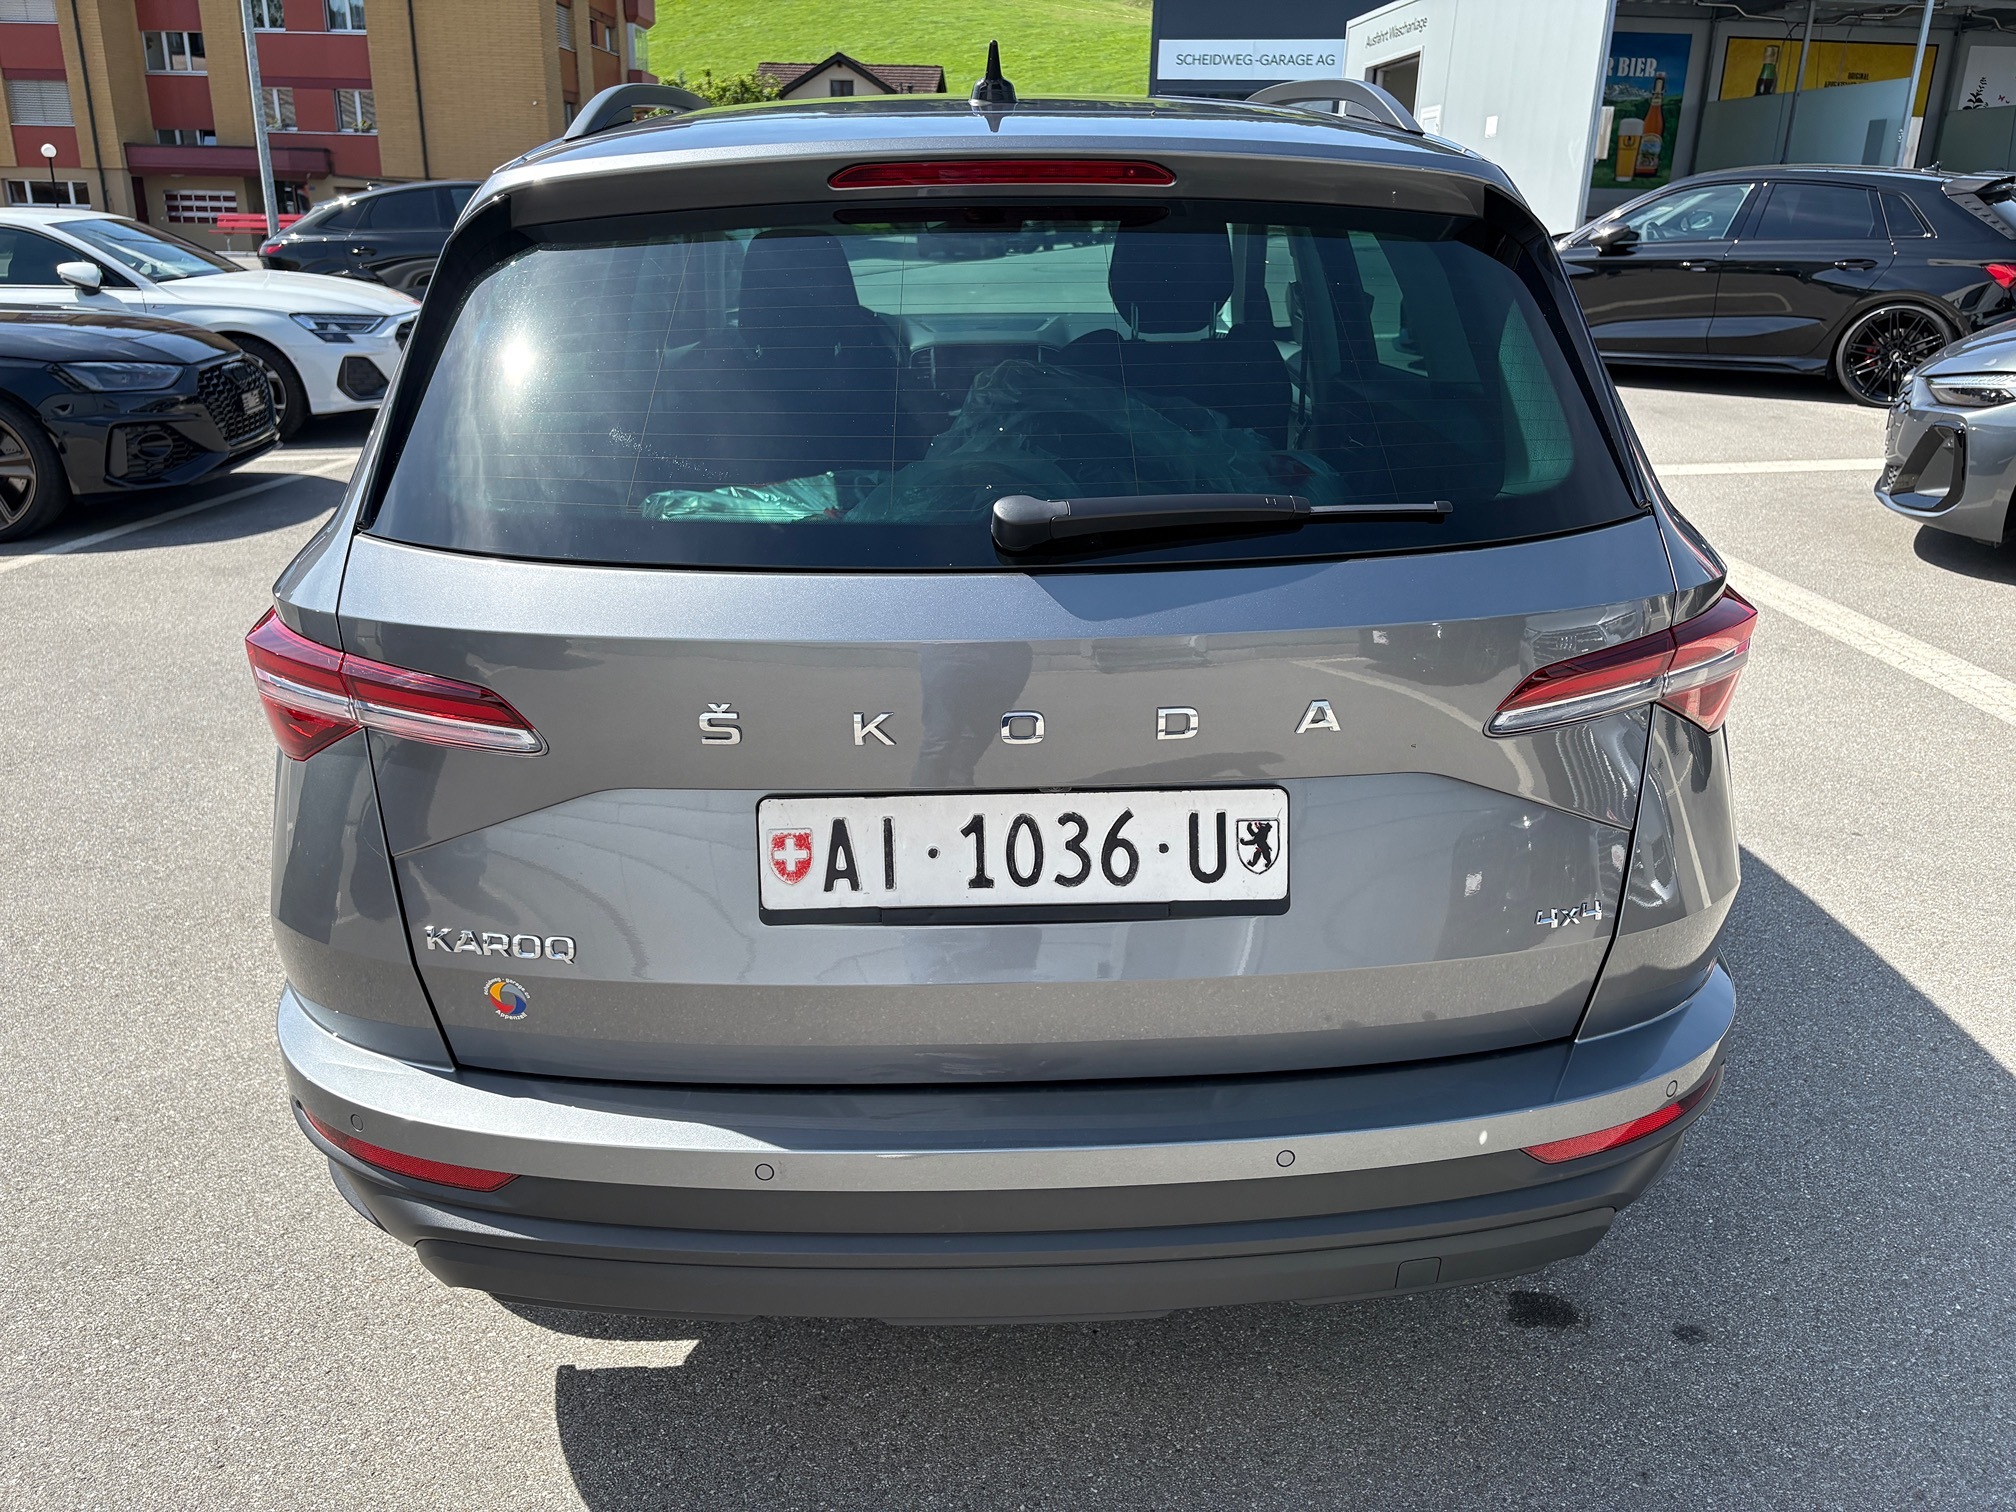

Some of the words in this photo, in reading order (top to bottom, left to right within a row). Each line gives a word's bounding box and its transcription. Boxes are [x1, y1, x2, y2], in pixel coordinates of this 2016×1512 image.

[1365, 29, 1388, 48] Ausfahrt
[1175, 53, 1253, 66] SCHEIDWEG
[1315, 53, 1336, 66] AG
[1616, 57, 1658, 77] BIER
[823, 815, 897, 892] AI
[960, 808, 1140, 889] 1036
[1189, 810, 1228, 884] U
[424, 925, 577, 965] KAROQ
